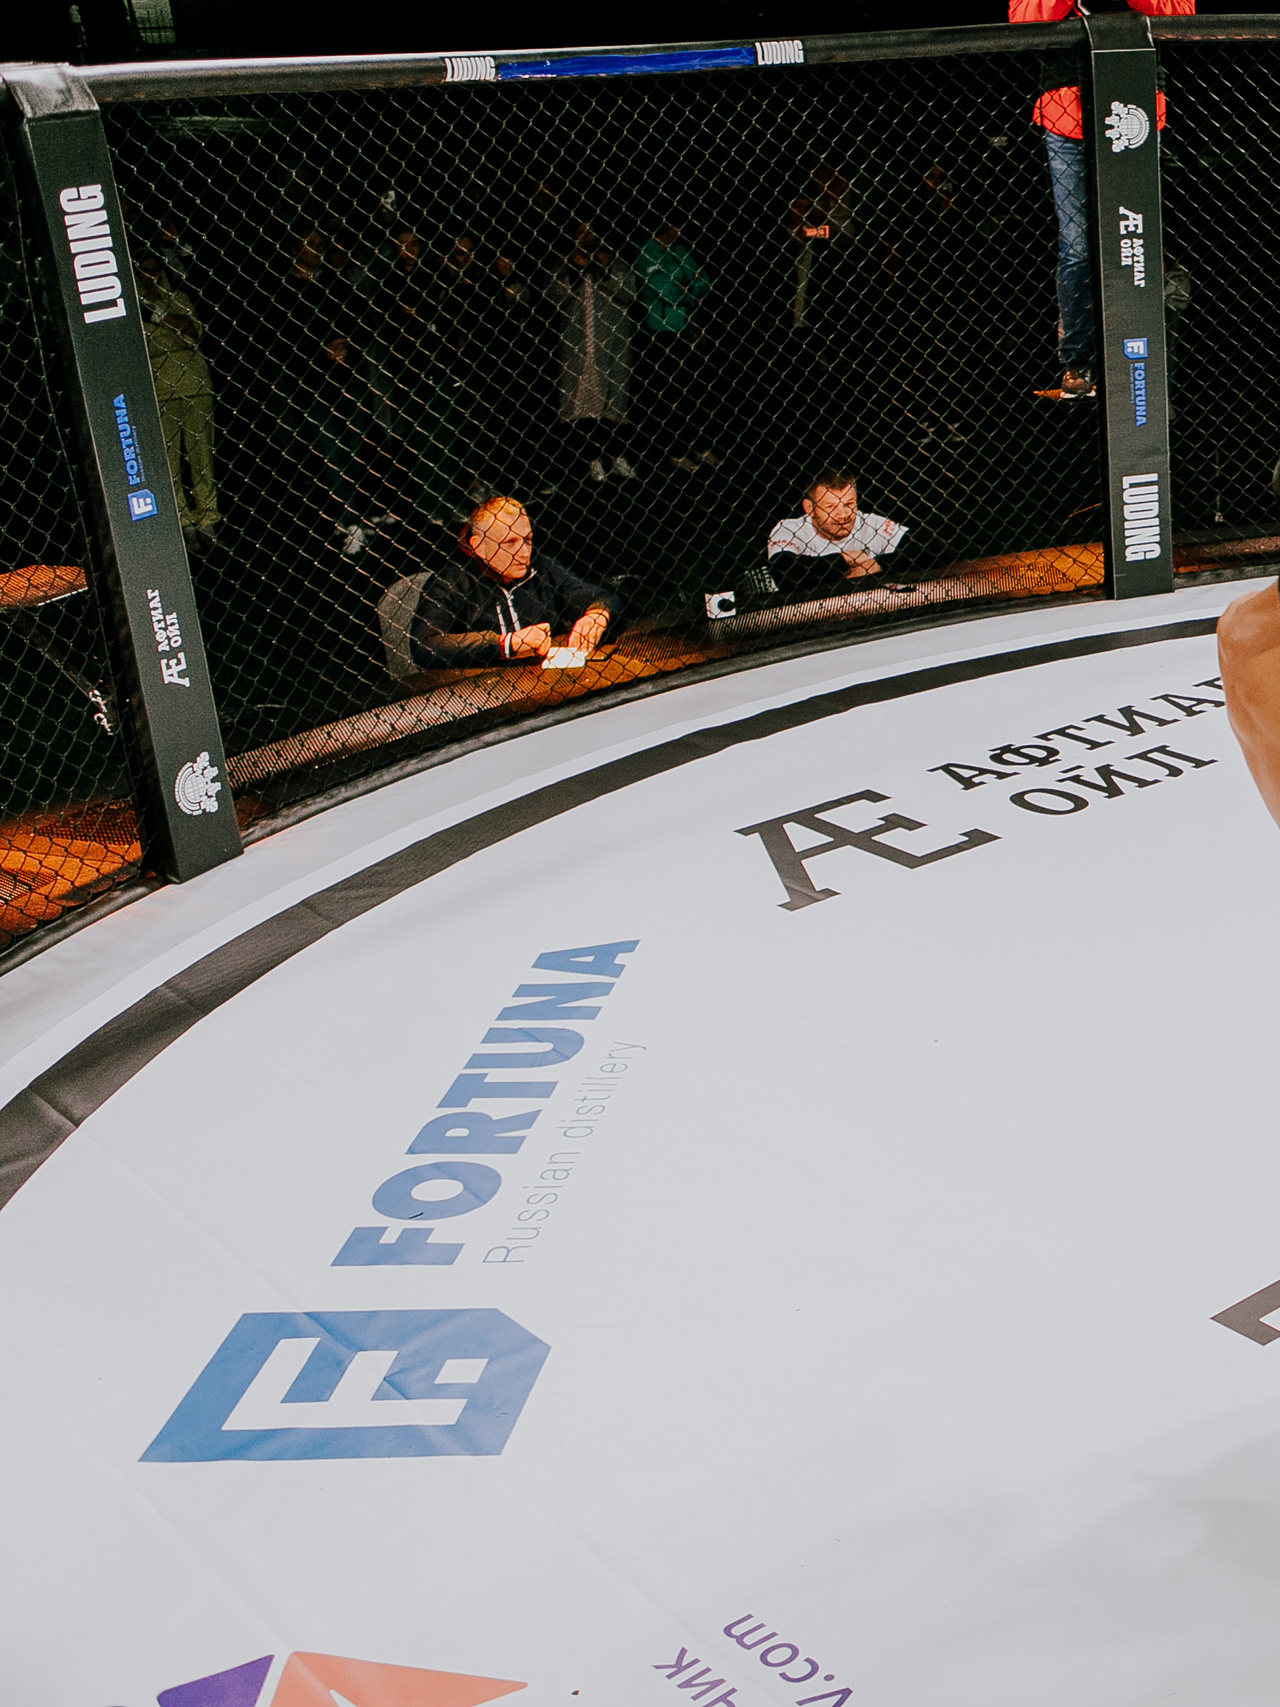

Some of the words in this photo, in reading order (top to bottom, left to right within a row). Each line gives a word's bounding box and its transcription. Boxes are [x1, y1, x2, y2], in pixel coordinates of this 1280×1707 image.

[444, 56, 496, 82] LUDING
[754, 40, 804, 65] LUDING
[59, 184, 127, 324] LUDING
[1134, 362, 1148, 427] FORTUNA
[112, 393, 141, 486] FORTUNA
[1122, 473, 1161, 562] LUDING
[1008, 745, 1219, 816] ОЙЛ
[330, 939, 641, 1267] FORTUNA
[482, 1151, 581, 1264] Russian
[556, 1041, 647, 1139] distillery
